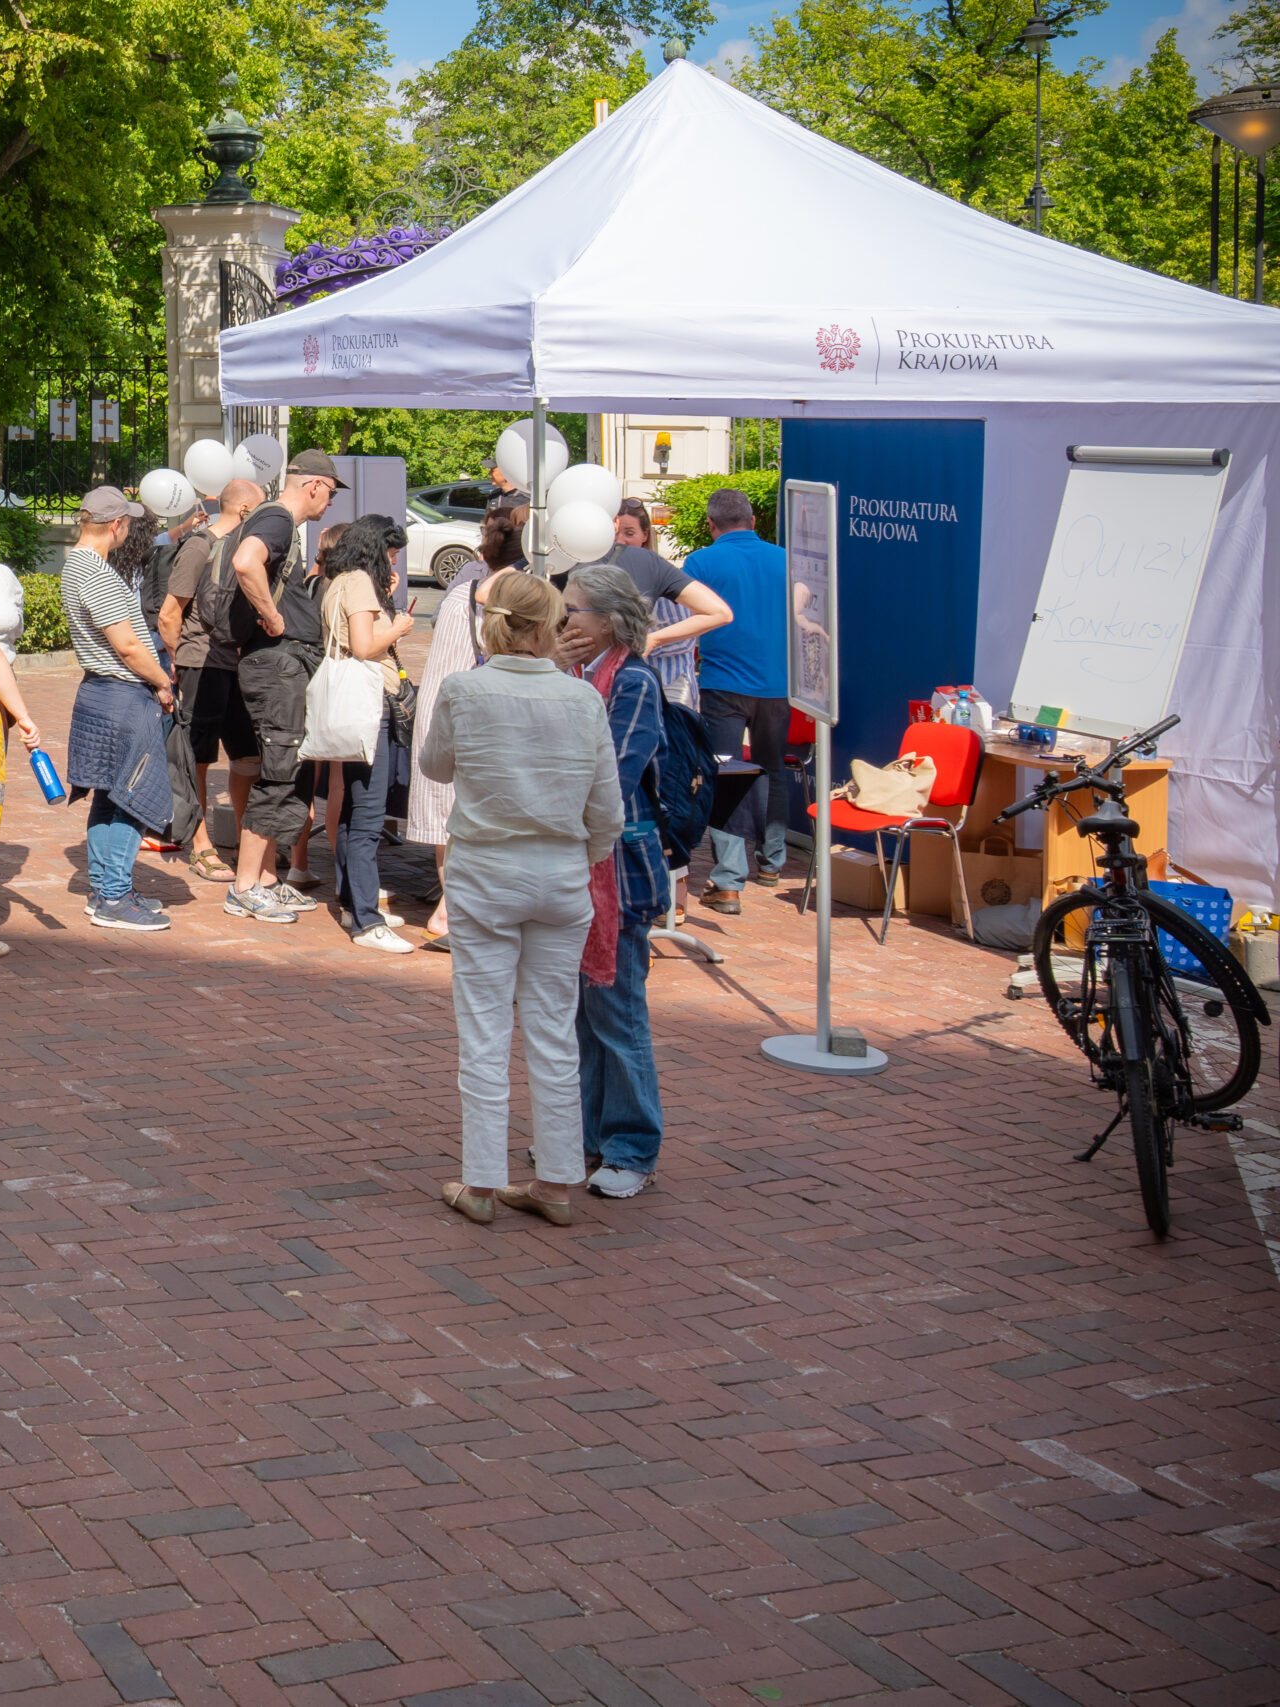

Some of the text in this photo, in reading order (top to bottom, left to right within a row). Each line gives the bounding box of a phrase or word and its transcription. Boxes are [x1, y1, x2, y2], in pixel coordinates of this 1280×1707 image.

[332, 333, 399, 351] PROKURATURA
[896, 330, 1054, 350] PROKURATURA
[331, 354, 372, 371] KRAJOWA
[898, 351, 999, 374] KRAJOWA
[849, 496, 959, 522] PROKURATURA
[849, 517, 919, 543] KRAJOWA
